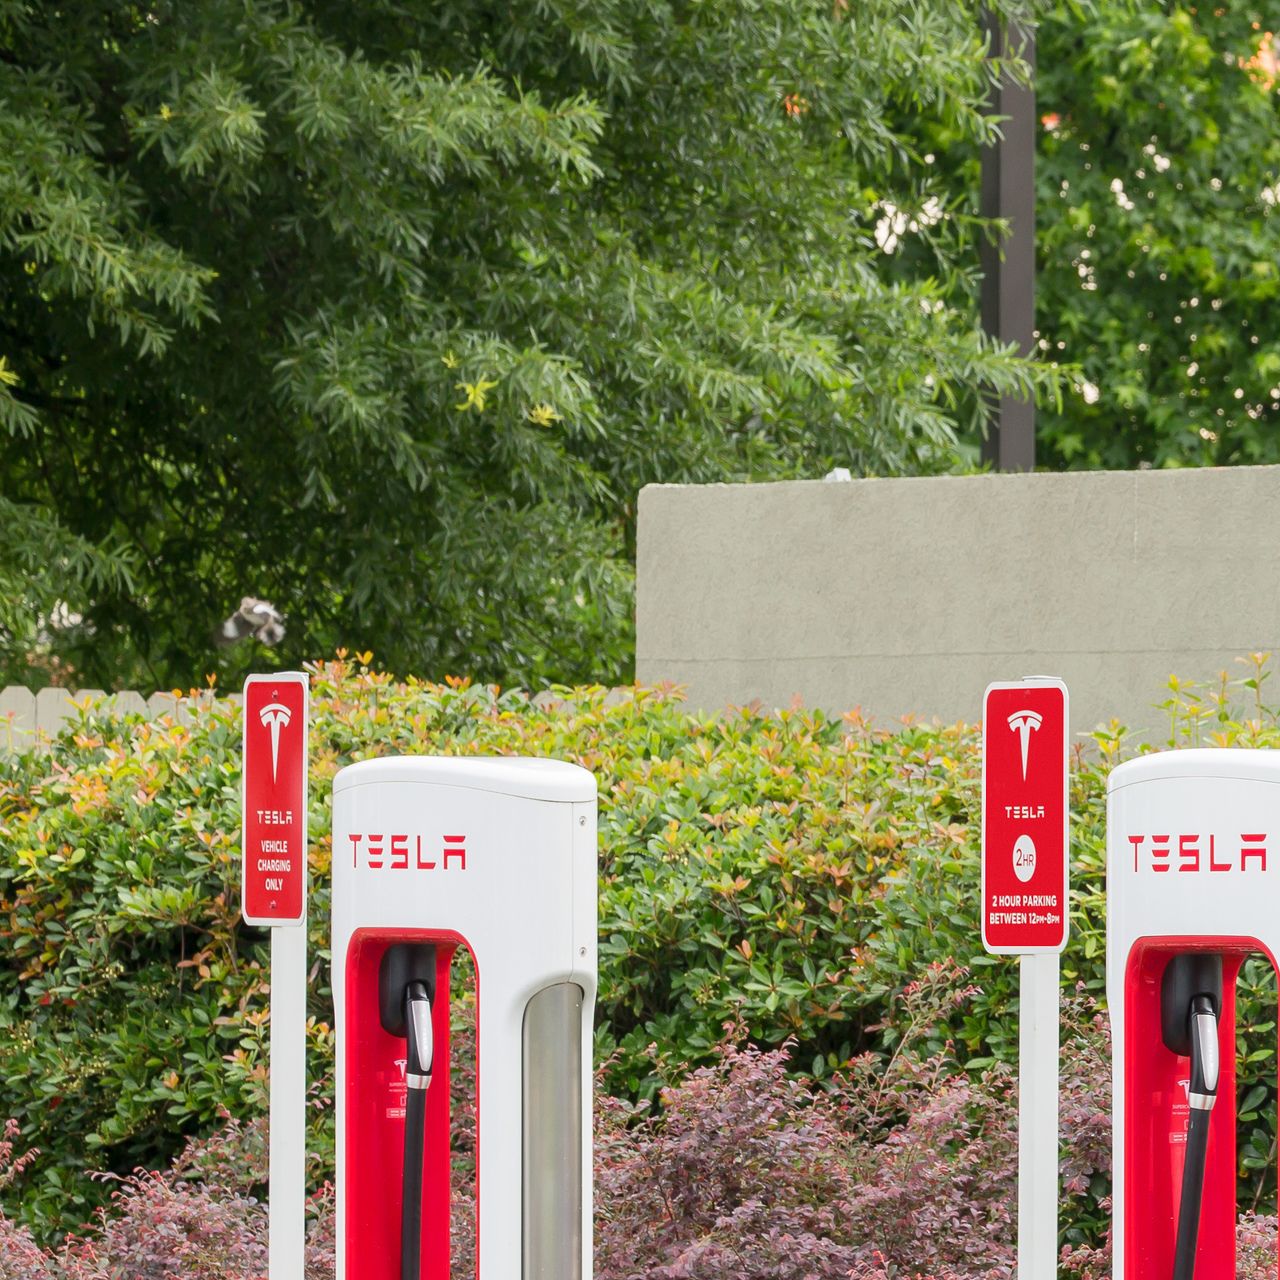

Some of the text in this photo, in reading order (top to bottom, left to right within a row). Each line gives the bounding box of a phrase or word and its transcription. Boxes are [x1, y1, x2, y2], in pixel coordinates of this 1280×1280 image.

[256, 810, 293, 825] TESLA
[1004, 805, 1045, 819] TESLA
[260, 840, 288, 854] VEHICLE
[348, 833, 467, 871] TESLA
[1127, 833, 1267, 873] TESLA
[257, 858, 291, 873] CHARGING
[265, 878, 284, 891] ONLY
[992, 894, 1057, 907] 2 HOUR PARKING
[989, 912, 1027, 925] BETWEEN
